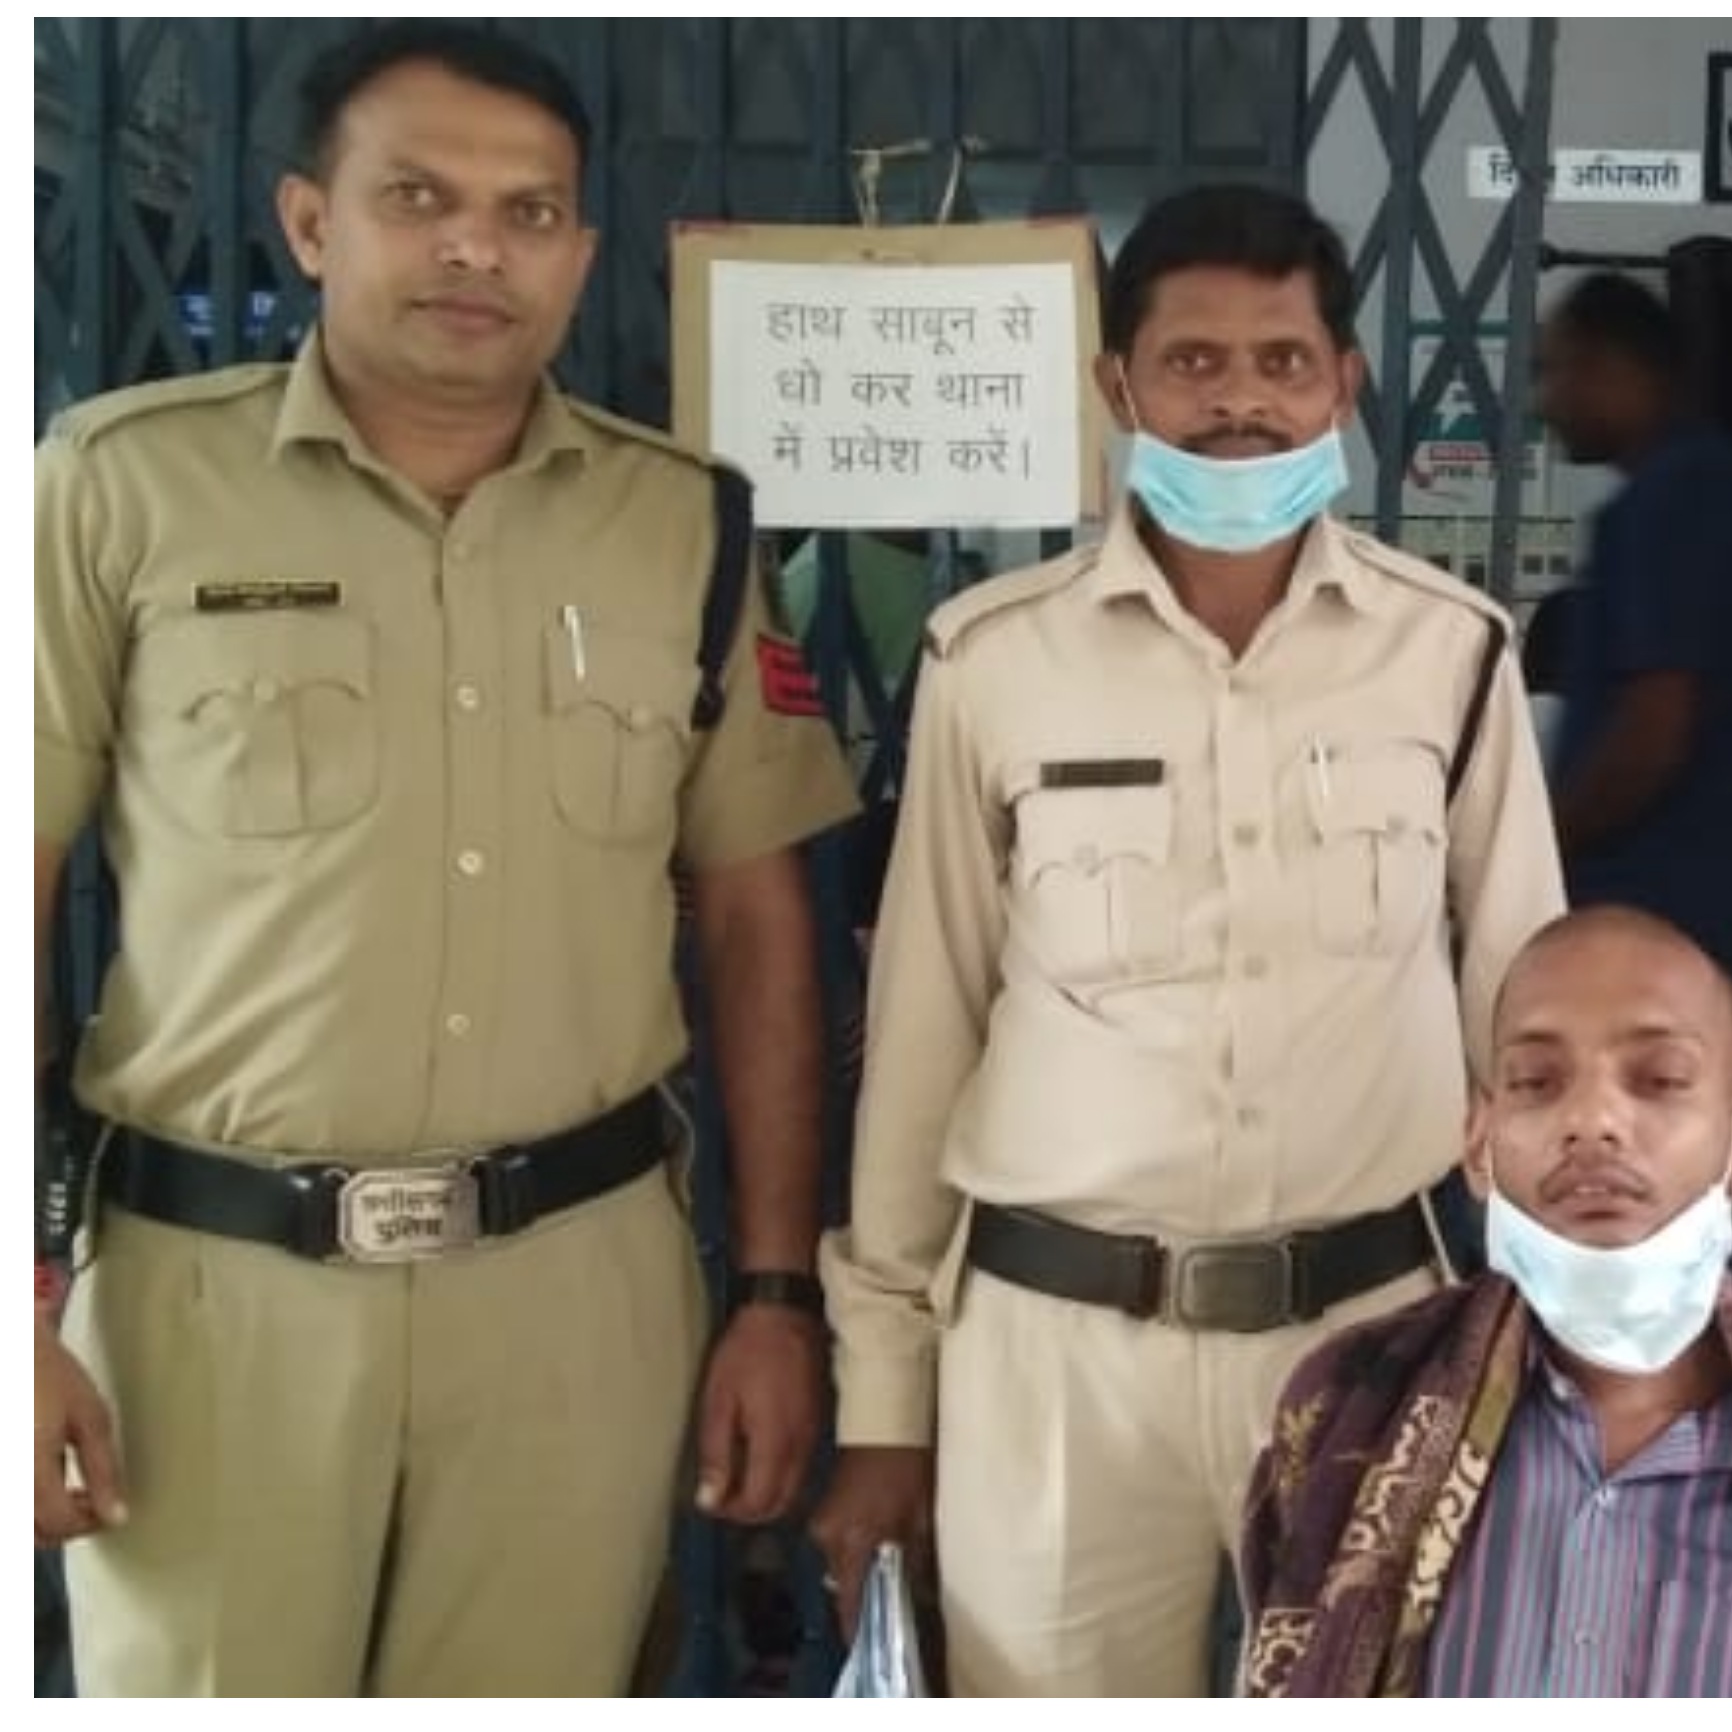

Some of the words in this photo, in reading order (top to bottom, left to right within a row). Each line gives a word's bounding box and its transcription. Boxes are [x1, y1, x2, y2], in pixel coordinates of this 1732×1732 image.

[765, 301, 848, 343] हाथ
[870, 304, 977, 355] साबून
[999, 293, 1038, 341] से
[774, 357, 823, 406] धो
[850, 371, 914, 408] कर
[934, 370, 1026, 409] थाना
[772, 421, 804, 471] में
[827, 425, 922, 474] प्रवेश
